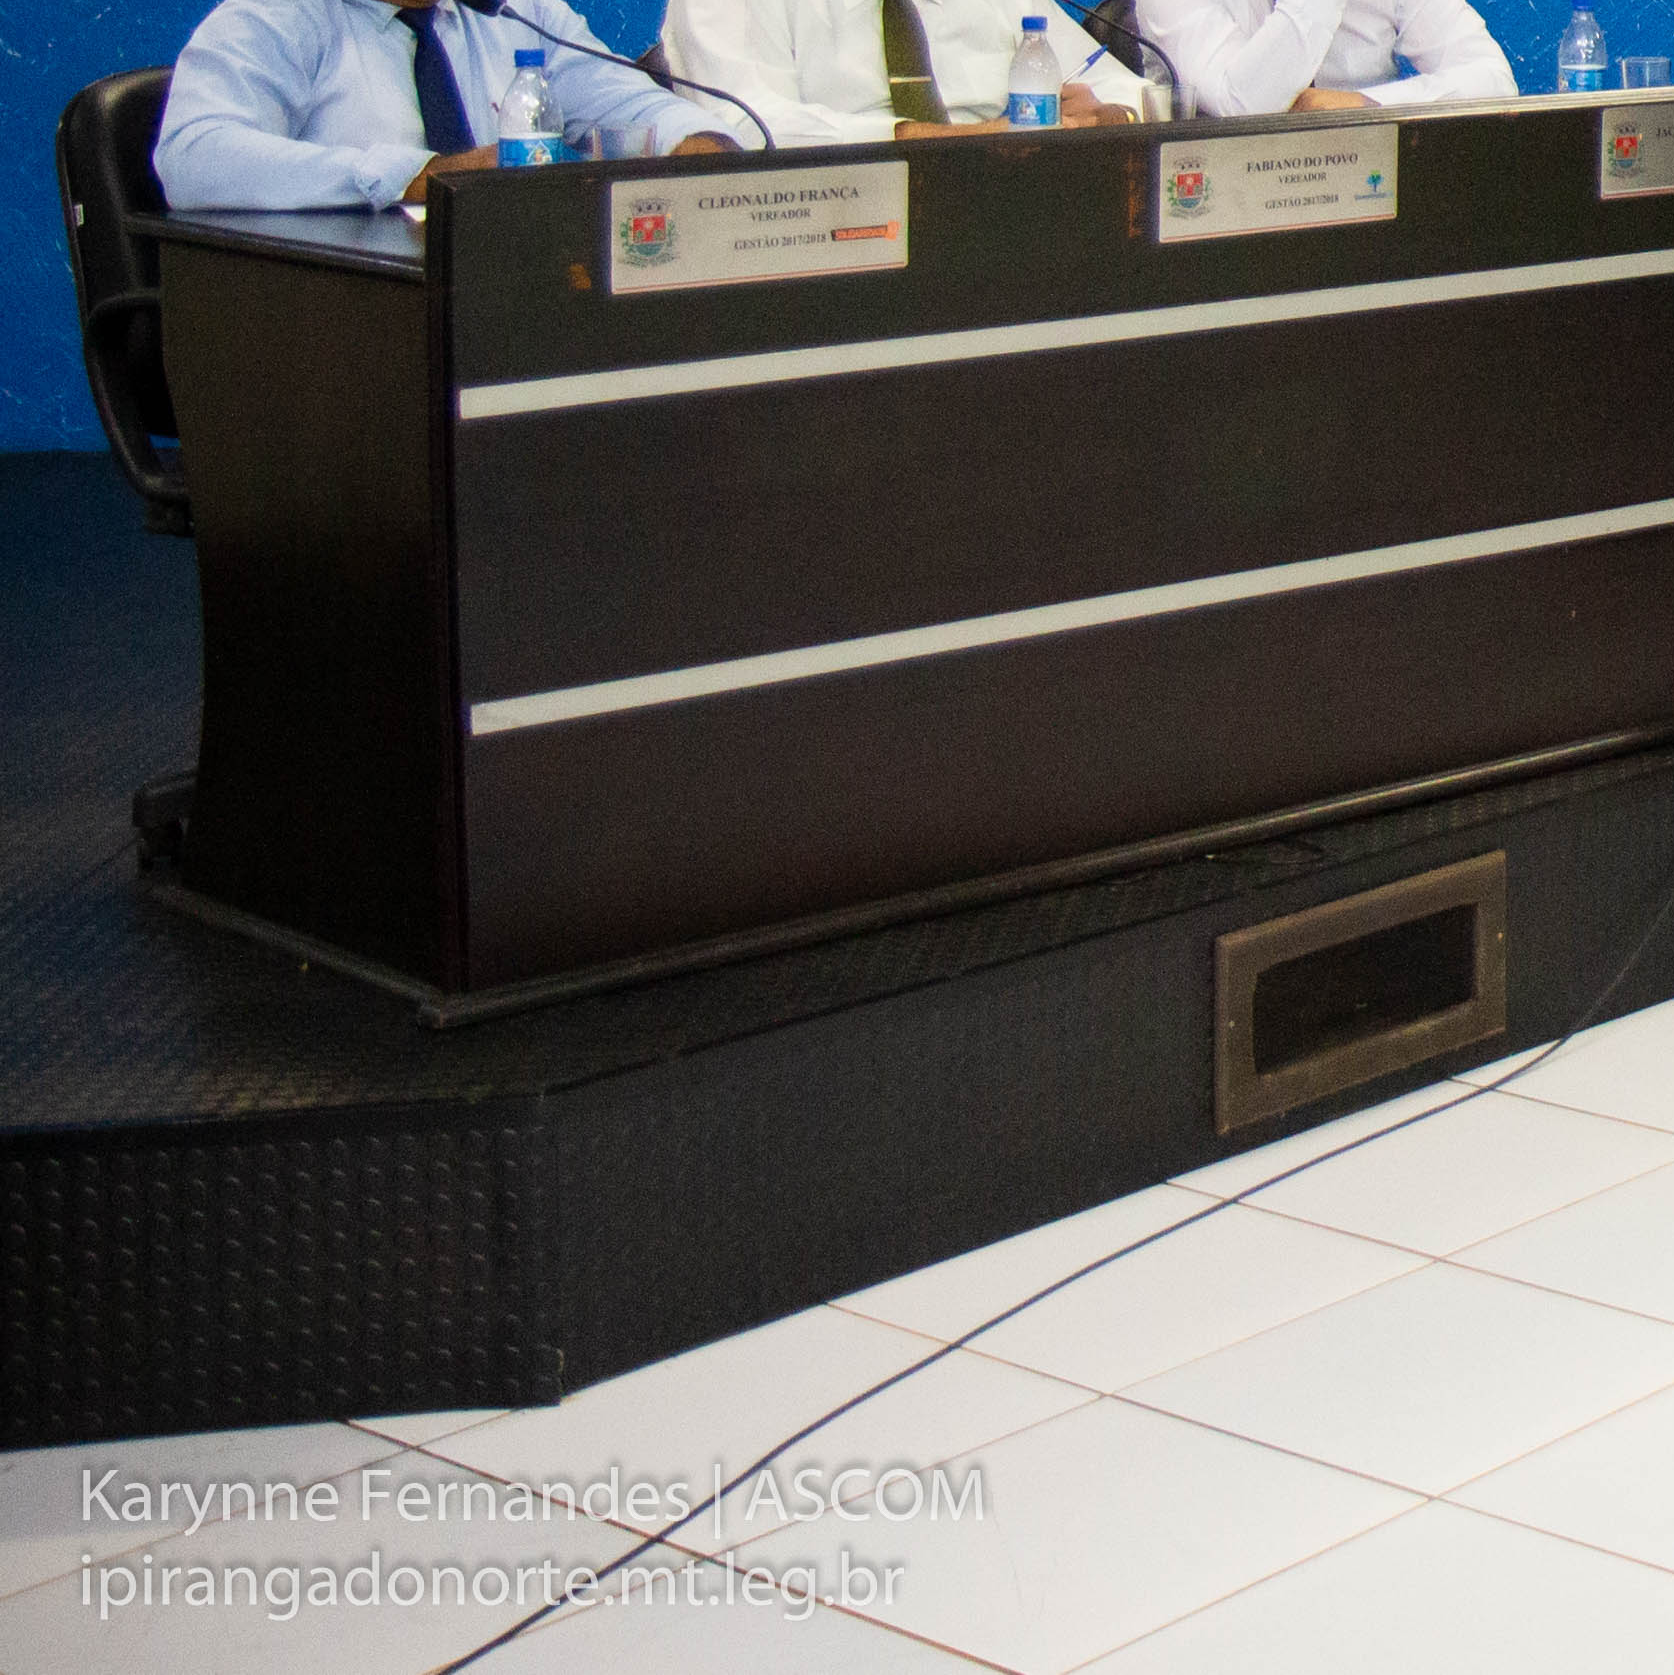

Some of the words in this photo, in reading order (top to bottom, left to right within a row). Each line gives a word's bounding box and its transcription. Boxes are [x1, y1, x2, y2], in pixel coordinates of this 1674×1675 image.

[1247, 158, 1301, 174] FABIANO
[1304, 156, 1322, 169] DO
[1325, 153, 1359, 168] POVO
[699, 191, 795, 211] CLEONALDO
[799, 186, 860, 204] FRANÇA
[750, 207, 811, 223] VEREADOR
[734, 234, 779, 251] GESTÃO
